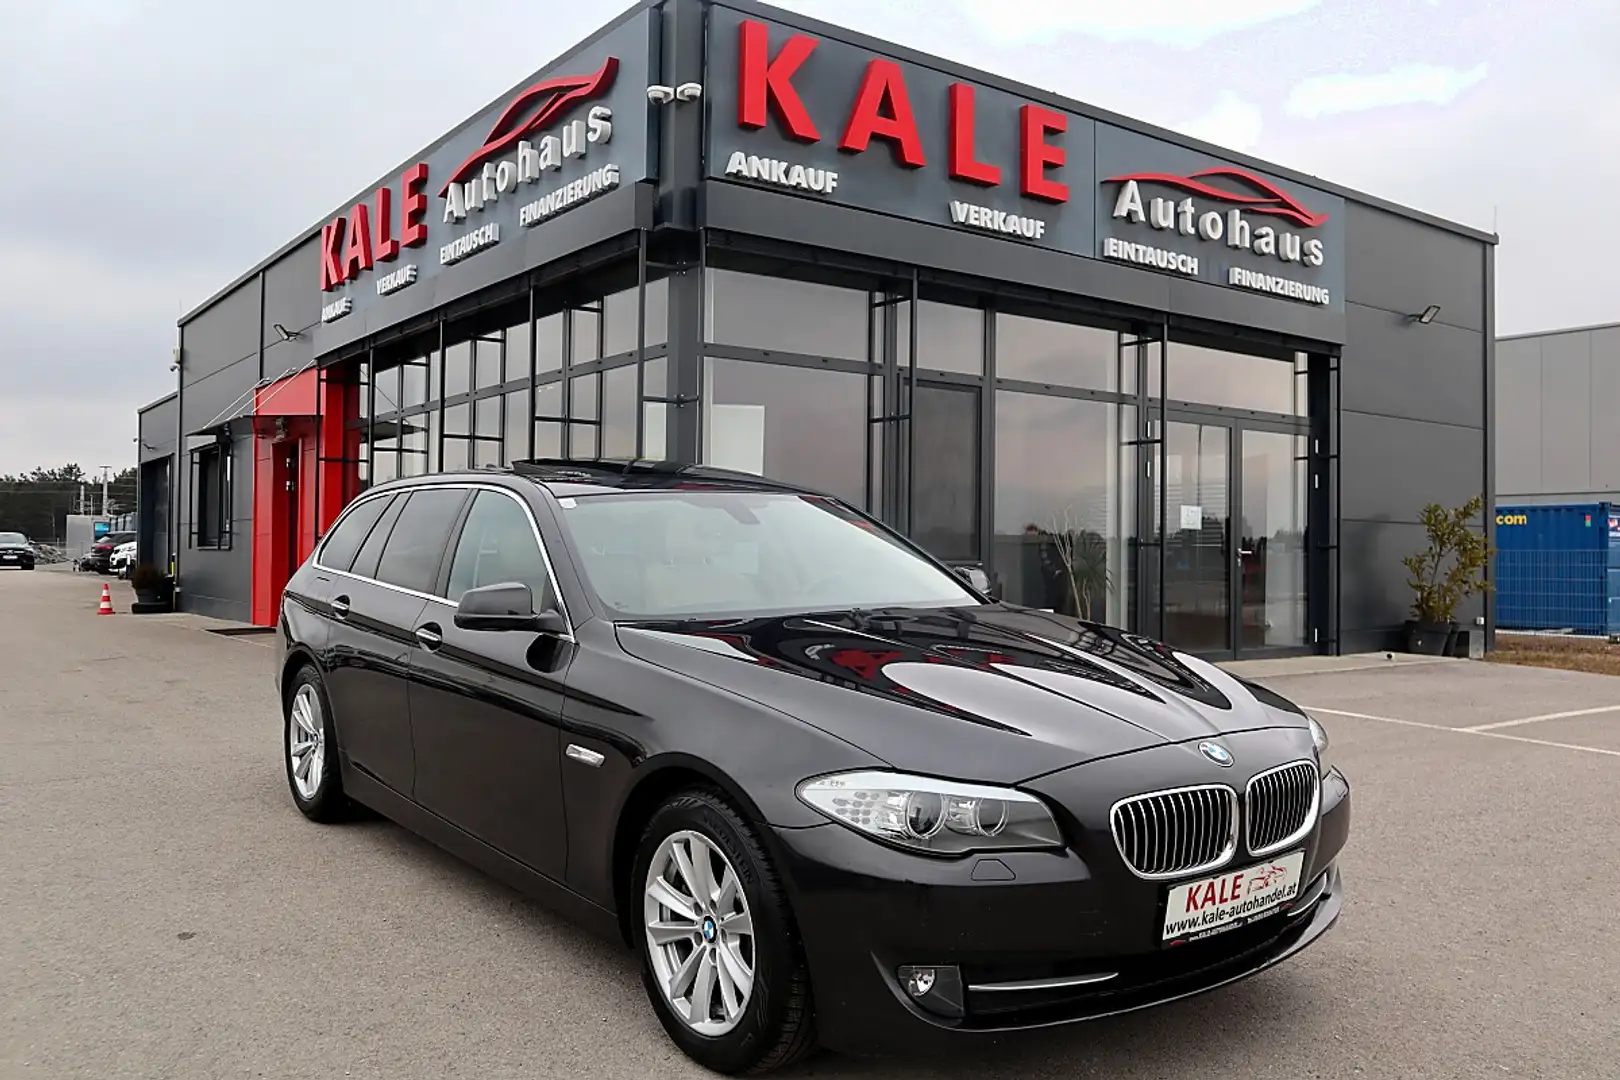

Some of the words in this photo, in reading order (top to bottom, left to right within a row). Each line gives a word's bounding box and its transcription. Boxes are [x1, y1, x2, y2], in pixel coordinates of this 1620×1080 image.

[321, 162, 429, 291] KALE
[443, 105, 612, 223] Autohaus
[738, 19, 1070, 203] KALE
[1113, 179, 1324, 267] Autohaus
[376, 264, 417, 295] VERKAUF
[440, 222, 500, 265] EINTAUSCH
[519, 163, 620, 227] FINANZIERUNG
[725, 151, 838, 195] ANKAUF
[949, 200, 1045, 239] VERKAUF
[1104, 237, 1199, 276] EINTAUSCH
[1229, 267, 1329, 305] FINANZIERUNG
[1165, 882, 1297, 935] www.kale-autohandel.at
[1186, 873, 1244, 913] KALE
